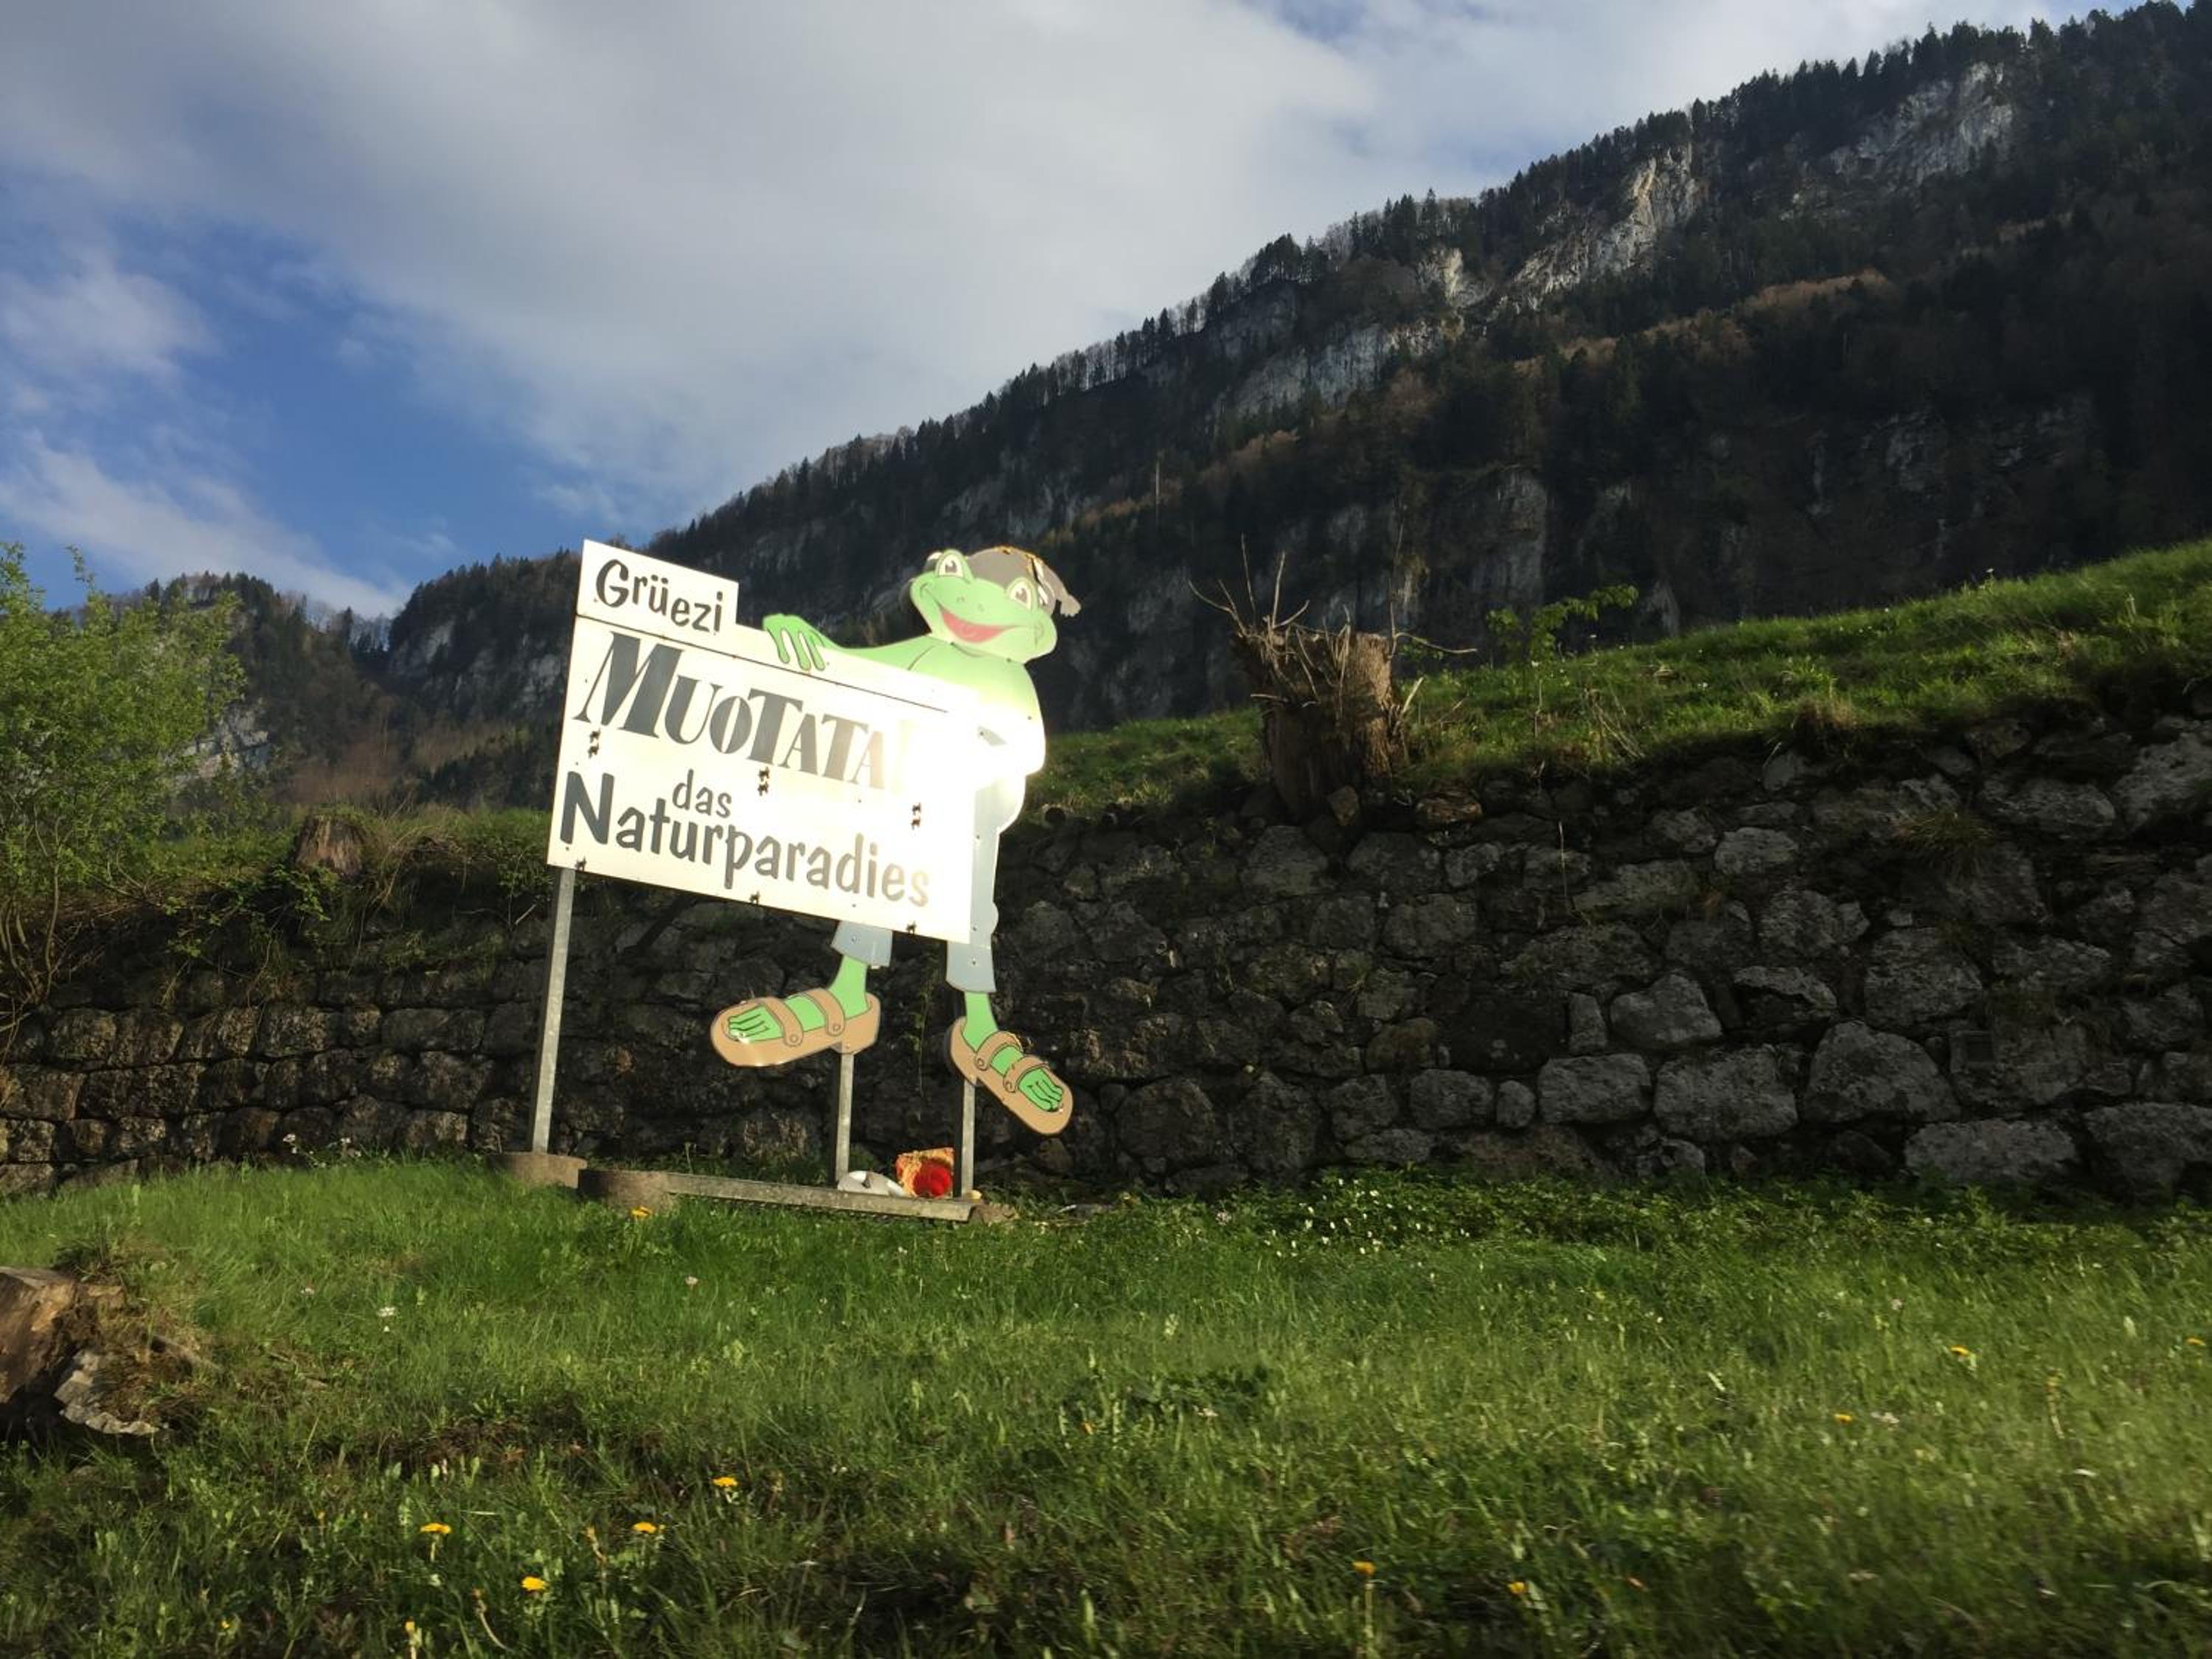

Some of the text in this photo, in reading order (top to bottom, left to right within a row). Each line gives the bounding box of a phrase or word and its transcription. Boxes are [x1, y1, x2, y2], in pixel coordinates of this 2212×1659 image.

[596, 559, 723, 634] Grüezi
[573, 631, 911, 793] MUOTATA
[559, 771, 930, 908] Naturparadies
[672, 769, 732, 819] das
